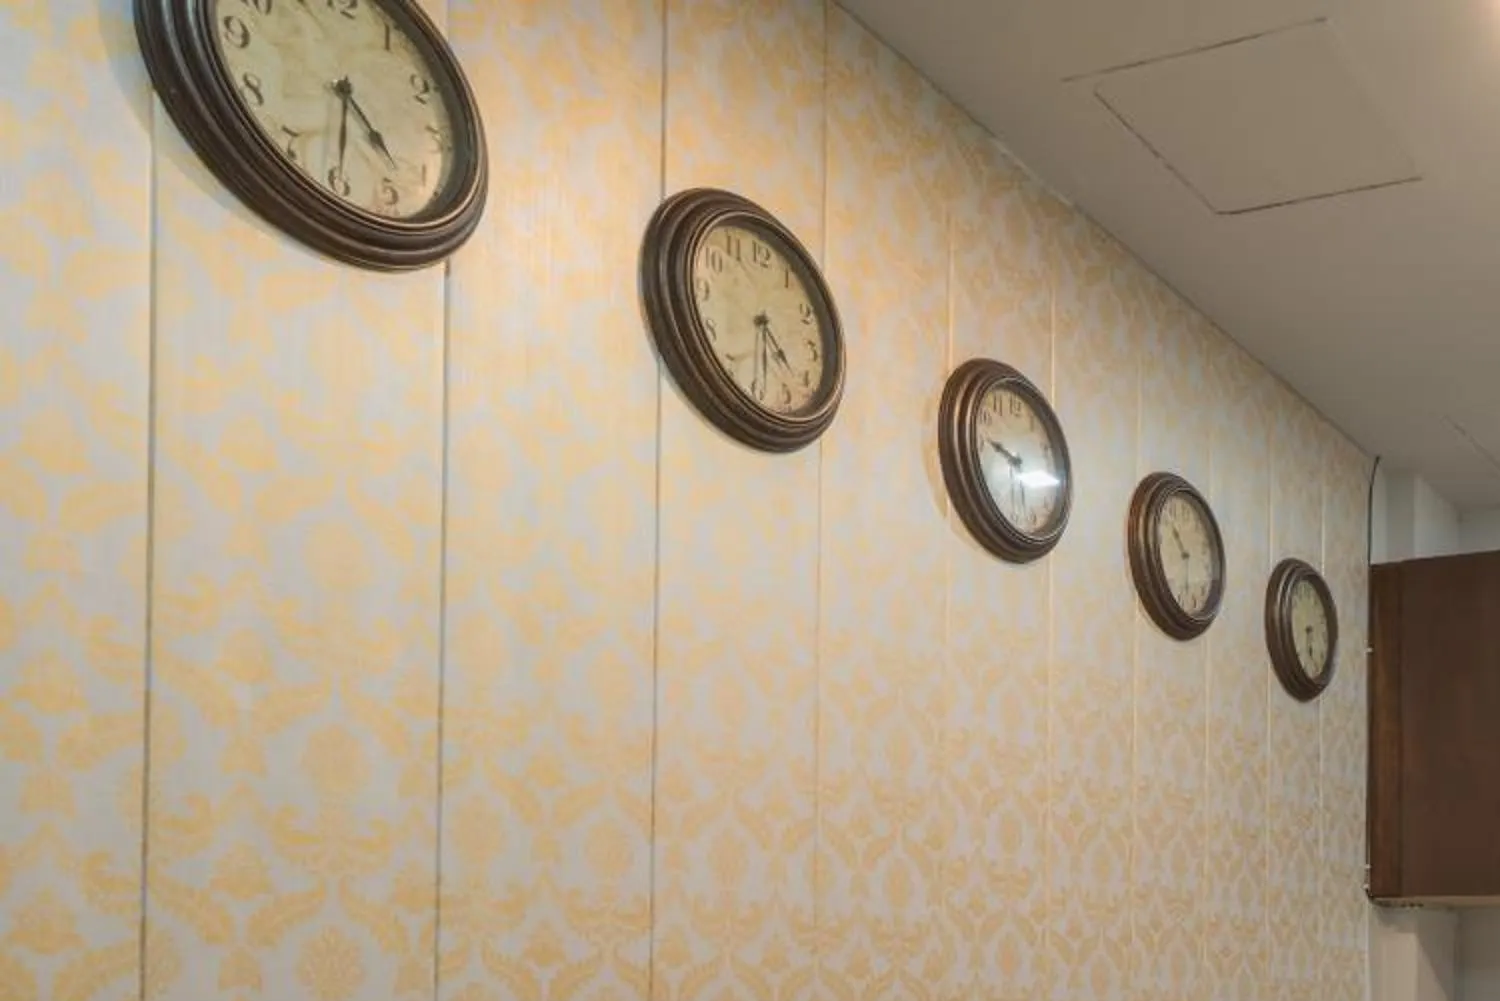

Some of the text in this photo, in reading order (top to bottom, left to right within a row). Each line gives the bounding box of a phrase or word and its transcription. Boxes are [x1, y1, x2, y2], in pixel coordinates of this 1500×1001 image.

[223, 15, 251, 49] 9
[383, 22, 392, 51] 1
[410, 74, 430, 105] 2
[382, 176, 399, 205] 5
[705, 247, 723, 273] 10
[751, 240, 771, 269] 12
